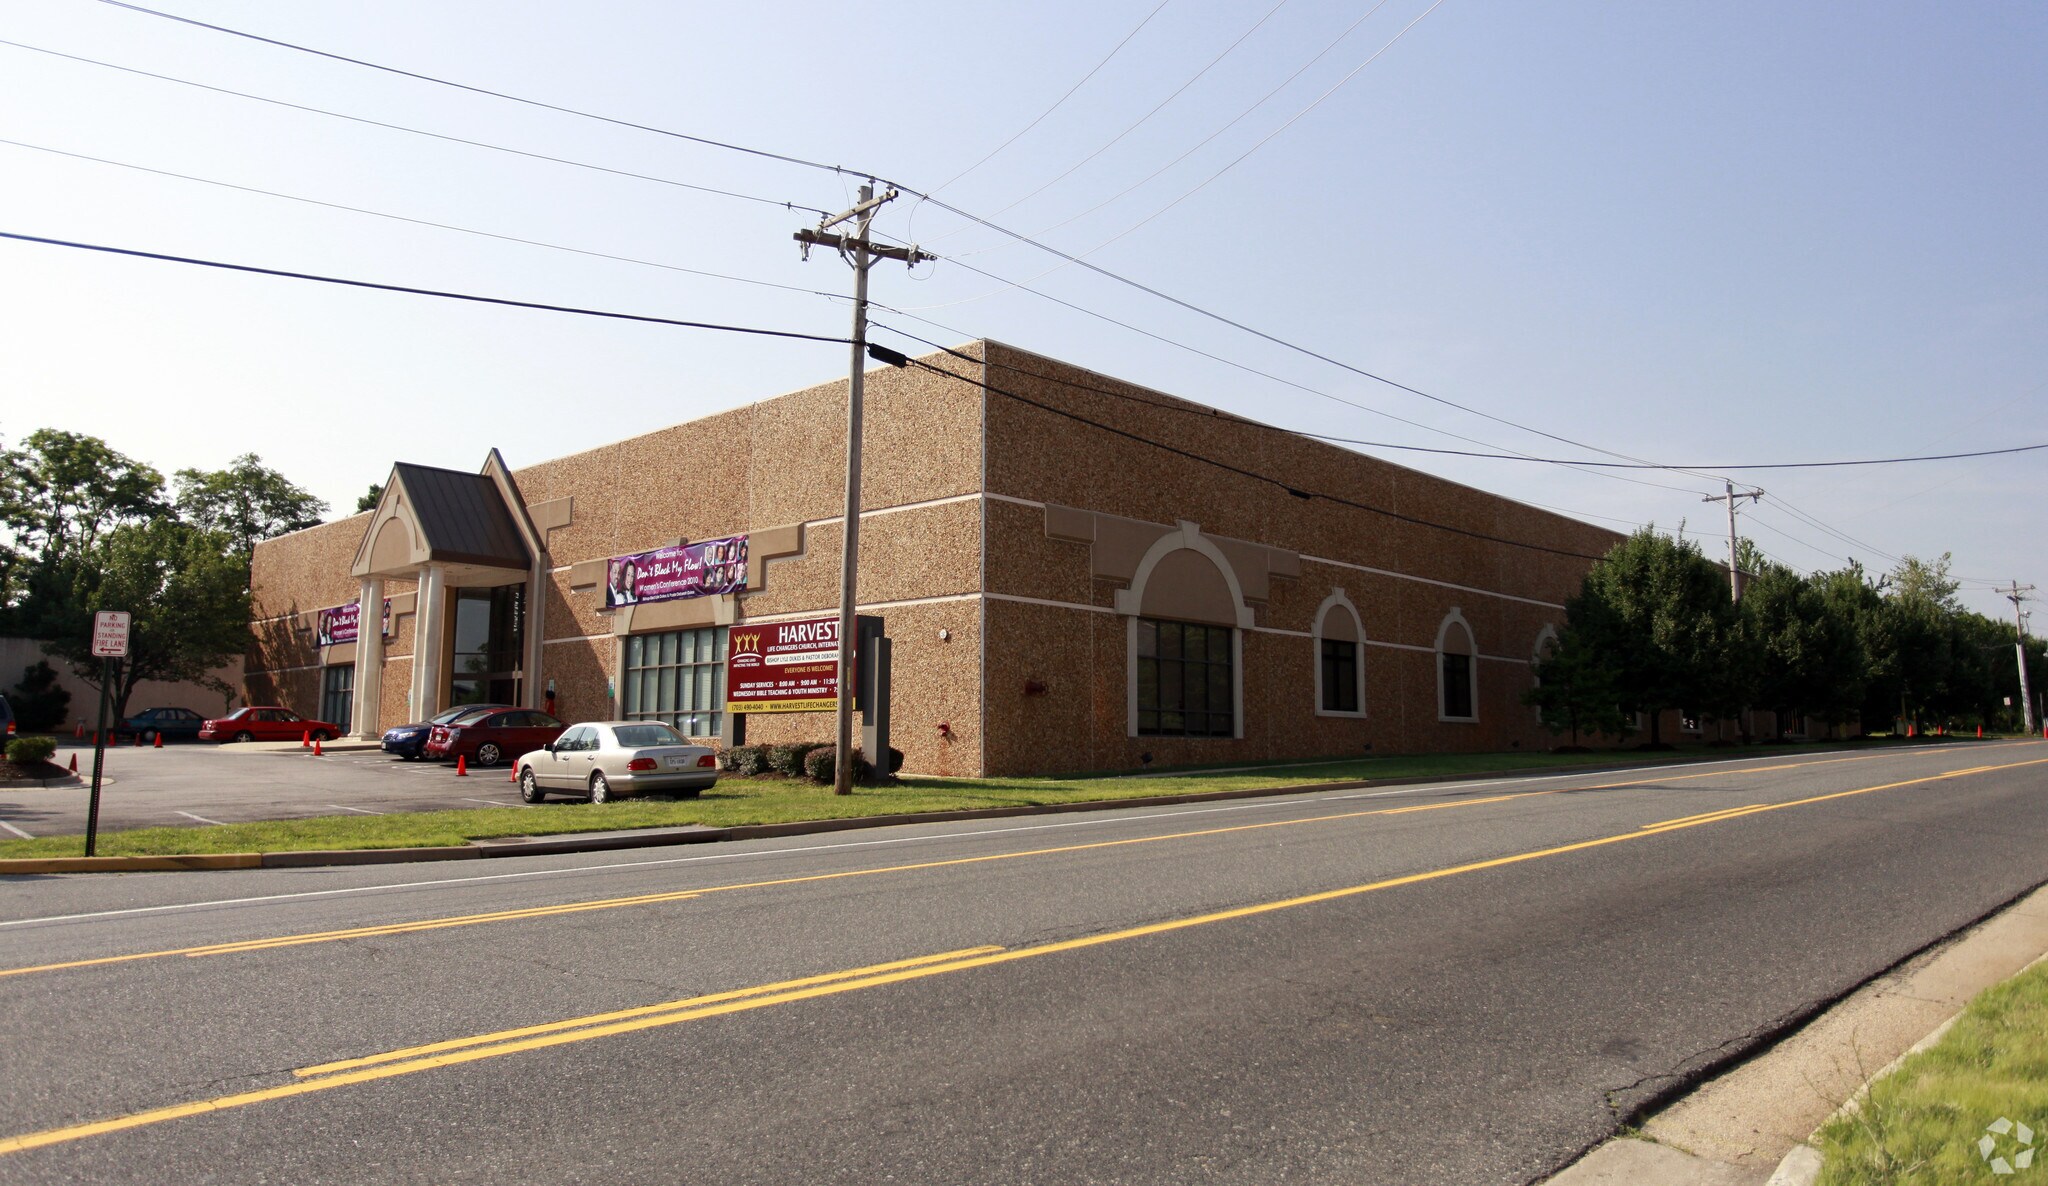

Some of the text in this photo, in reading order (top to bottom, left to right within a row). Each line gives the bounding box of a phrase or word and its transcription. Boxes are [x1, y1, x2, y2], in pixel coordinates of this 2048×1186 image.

[656, 550, 675, 560] Welcome
[637, 557, 702, 580] Don't Block My Flow!
[639, 576, 698, 592] Women's Conference 2010
[779, 621, 840, 643] HARVEST
[776, 643, 798, 652] CHANGERS
[799, 642, 818, 650] CHURCH,
